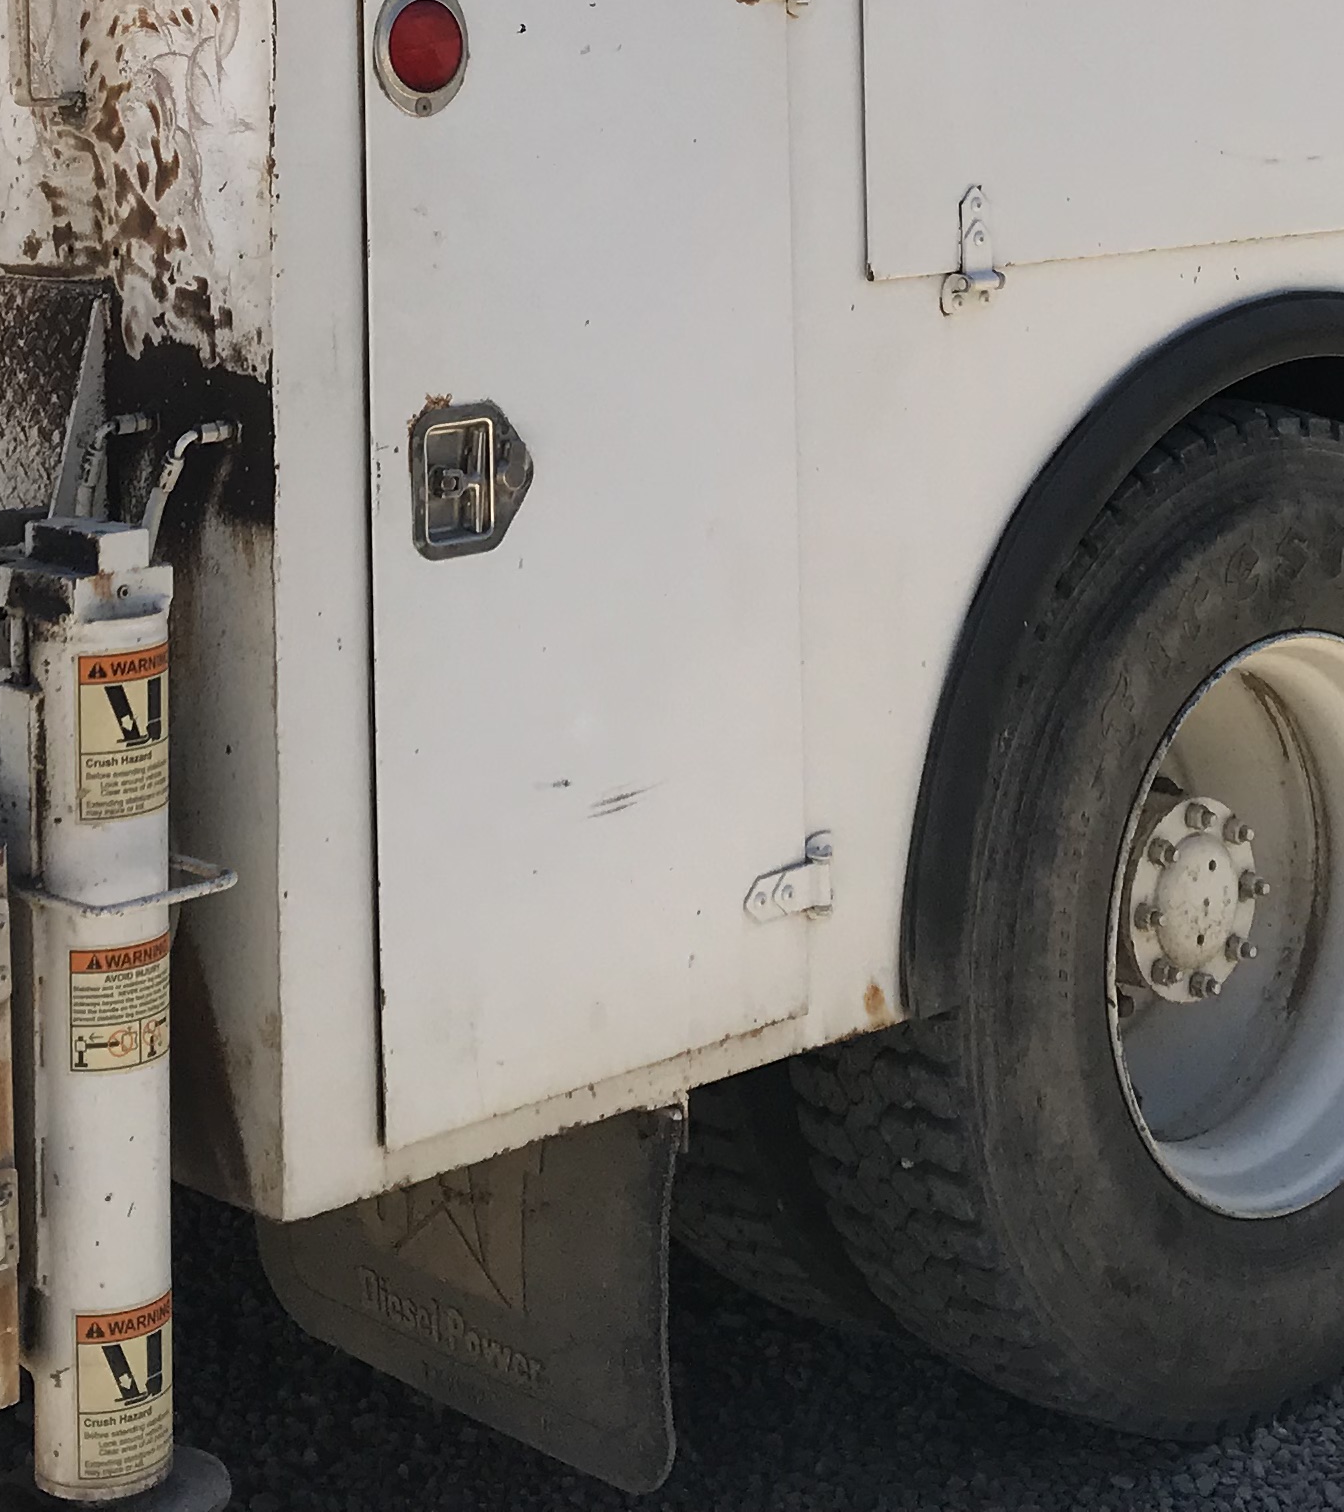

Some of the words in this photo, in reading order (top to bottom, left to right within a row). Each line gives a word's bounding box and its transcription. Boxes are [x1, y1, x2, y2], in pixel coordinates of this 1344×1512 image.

[86, 757, 118, 768] Crush
[121, 750, 152, 765] Hazard
[104, 972, 133, 983] AVOID
[84, 1417, 116, 1427] Crush
[119, 1406, 152, 1424] Hazard
